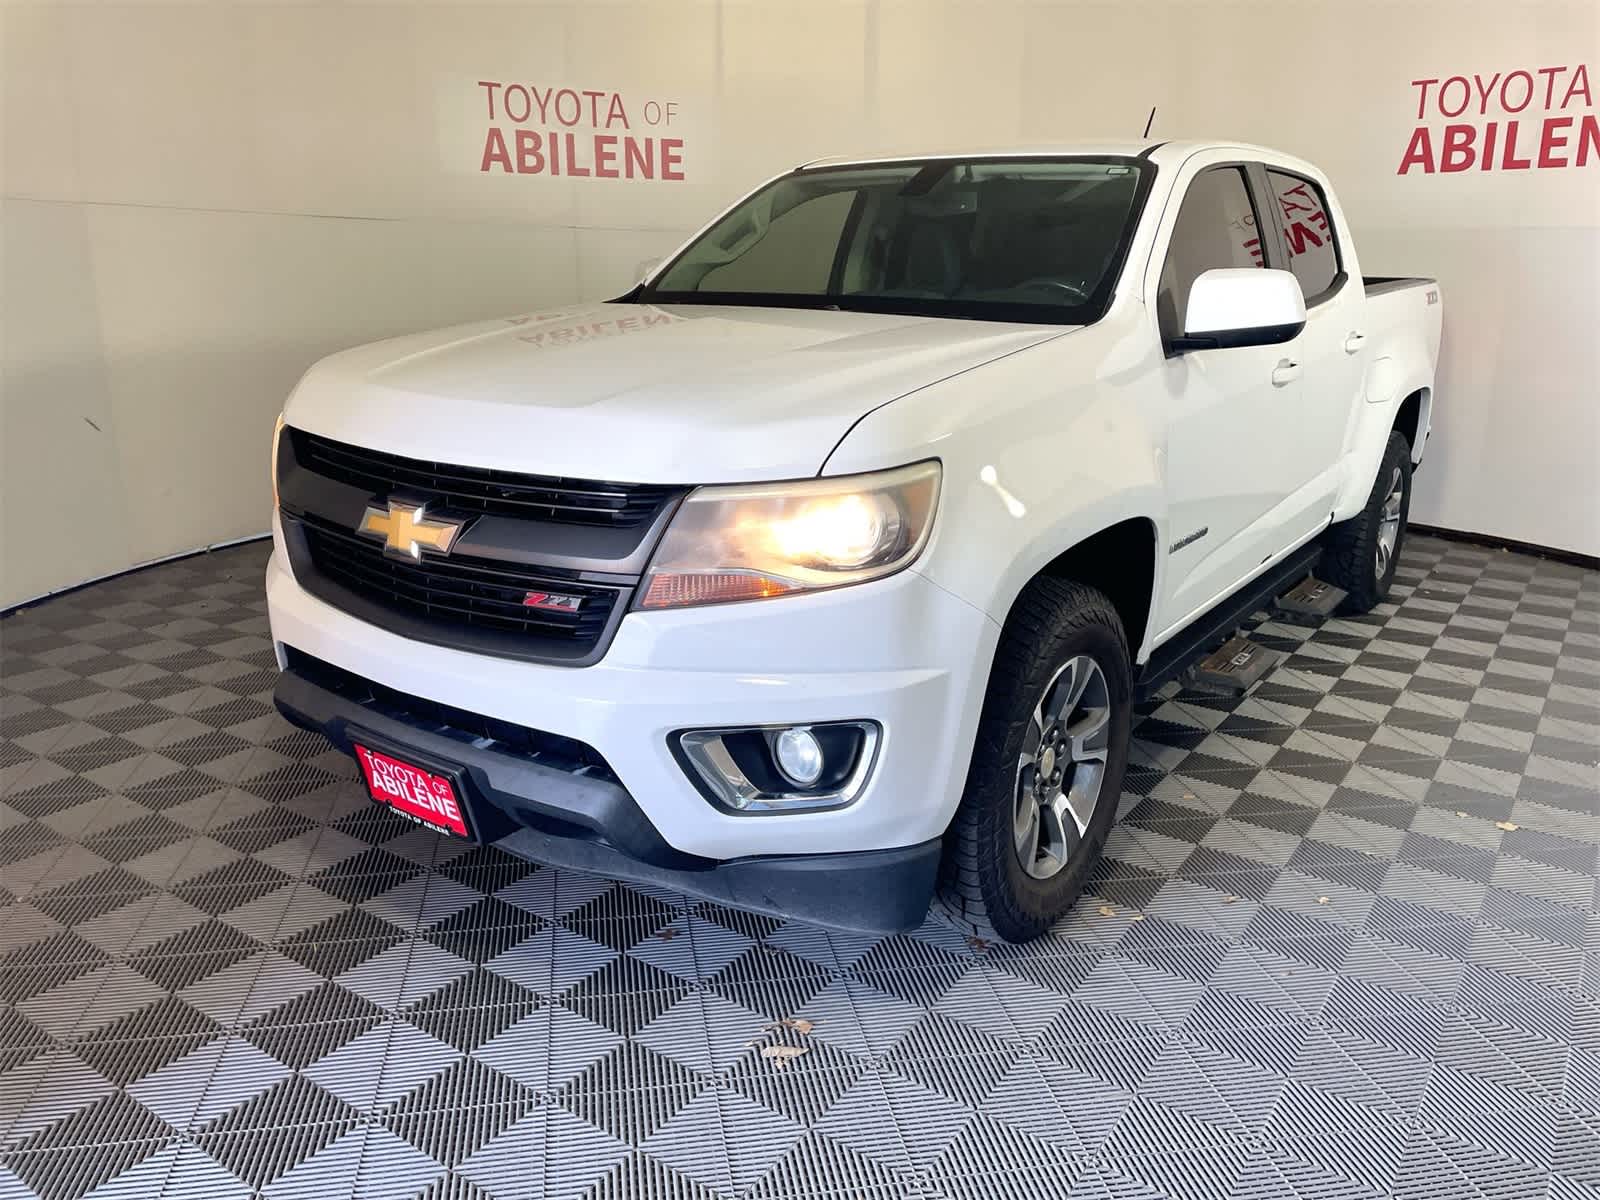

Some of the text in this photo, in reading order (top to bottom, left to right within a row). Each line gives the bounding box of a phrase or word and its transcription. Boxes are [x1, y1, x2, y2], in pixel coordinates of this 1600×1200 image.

[478, 81, 679, 129] TOYOTA OF
[1411, 64, 1592, 120] TOYOTA
[480, 127, 685, 180] ABILENE
[522, 591, 581, 612] Z71
[364, 752, 448, 796] TOYOTA OF
[372, 770, 461, 821] ABILENE
